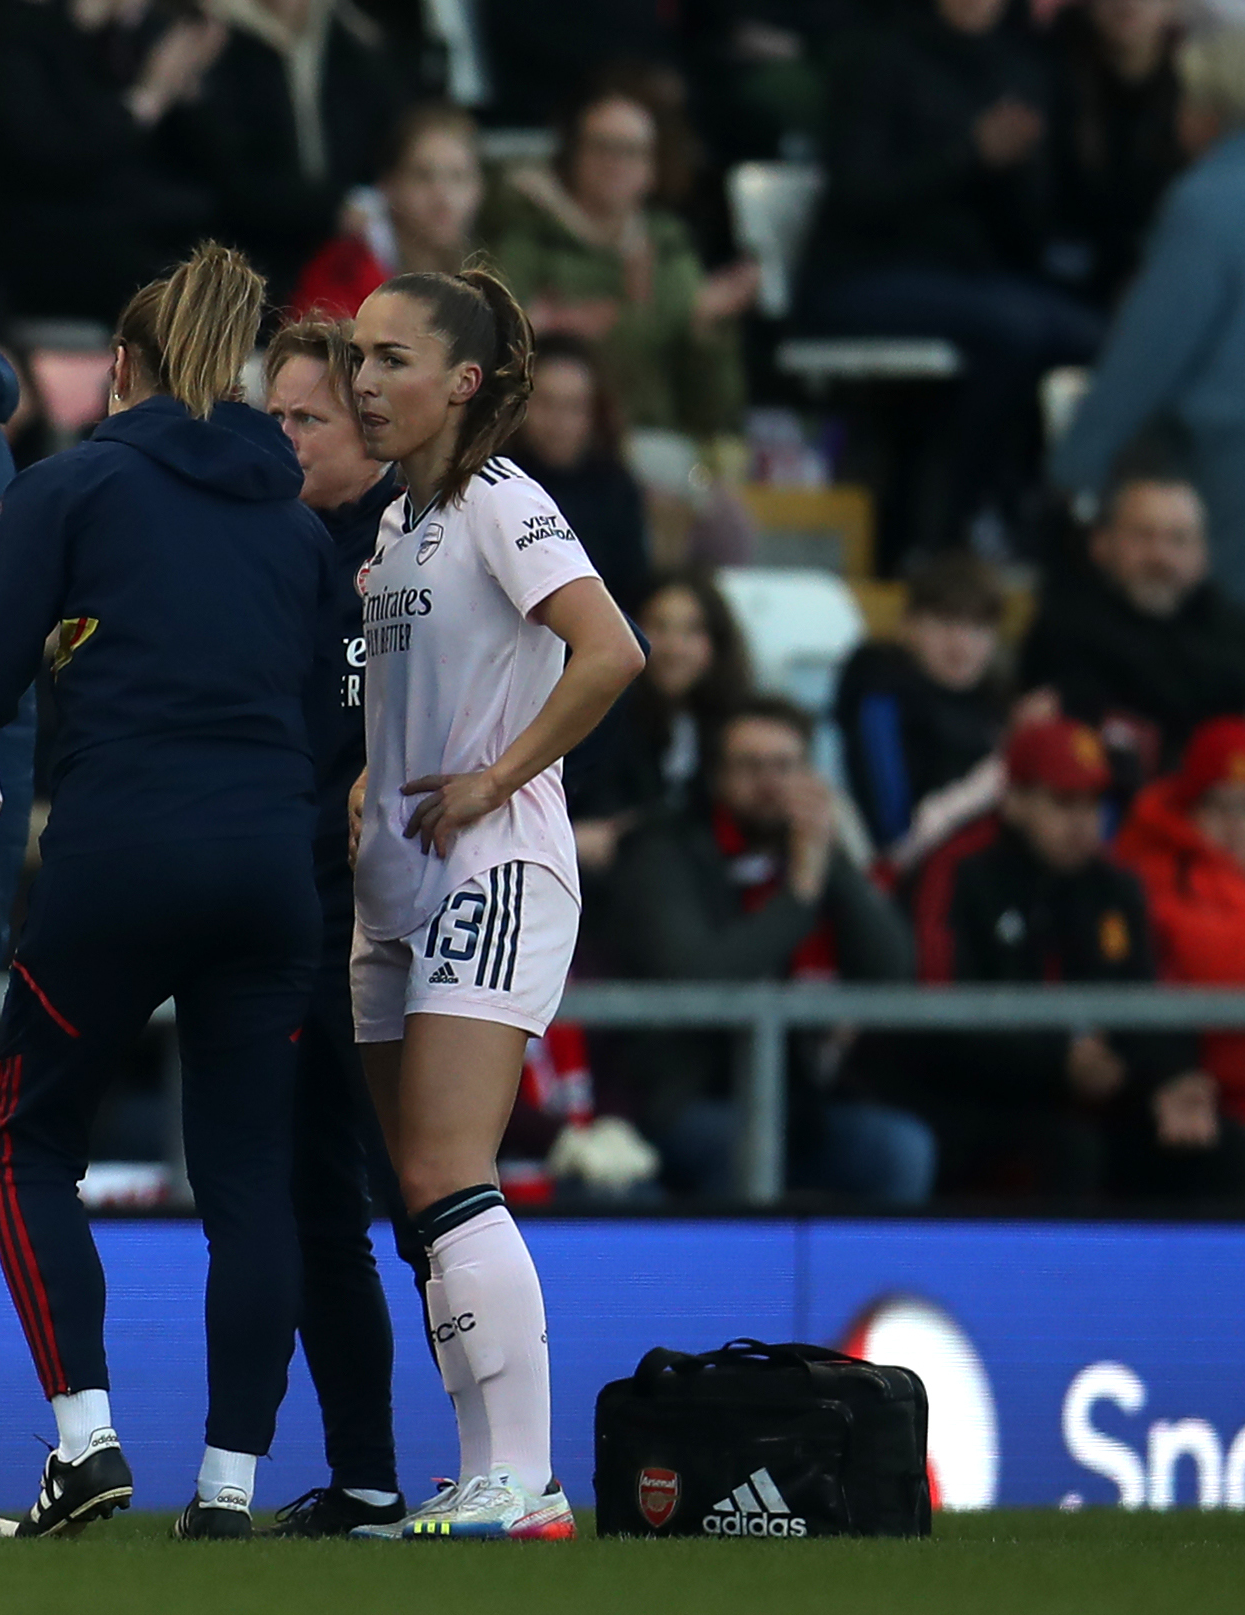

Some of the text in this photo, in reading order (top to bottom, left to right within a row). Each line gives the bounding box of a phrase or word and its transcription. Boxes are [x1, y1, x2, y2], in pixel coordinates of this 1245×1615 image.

[363, 585, 432, 623] mirates
[423, 891, 487, 961] 13
[702, 1511, 807, 1537] adidas
